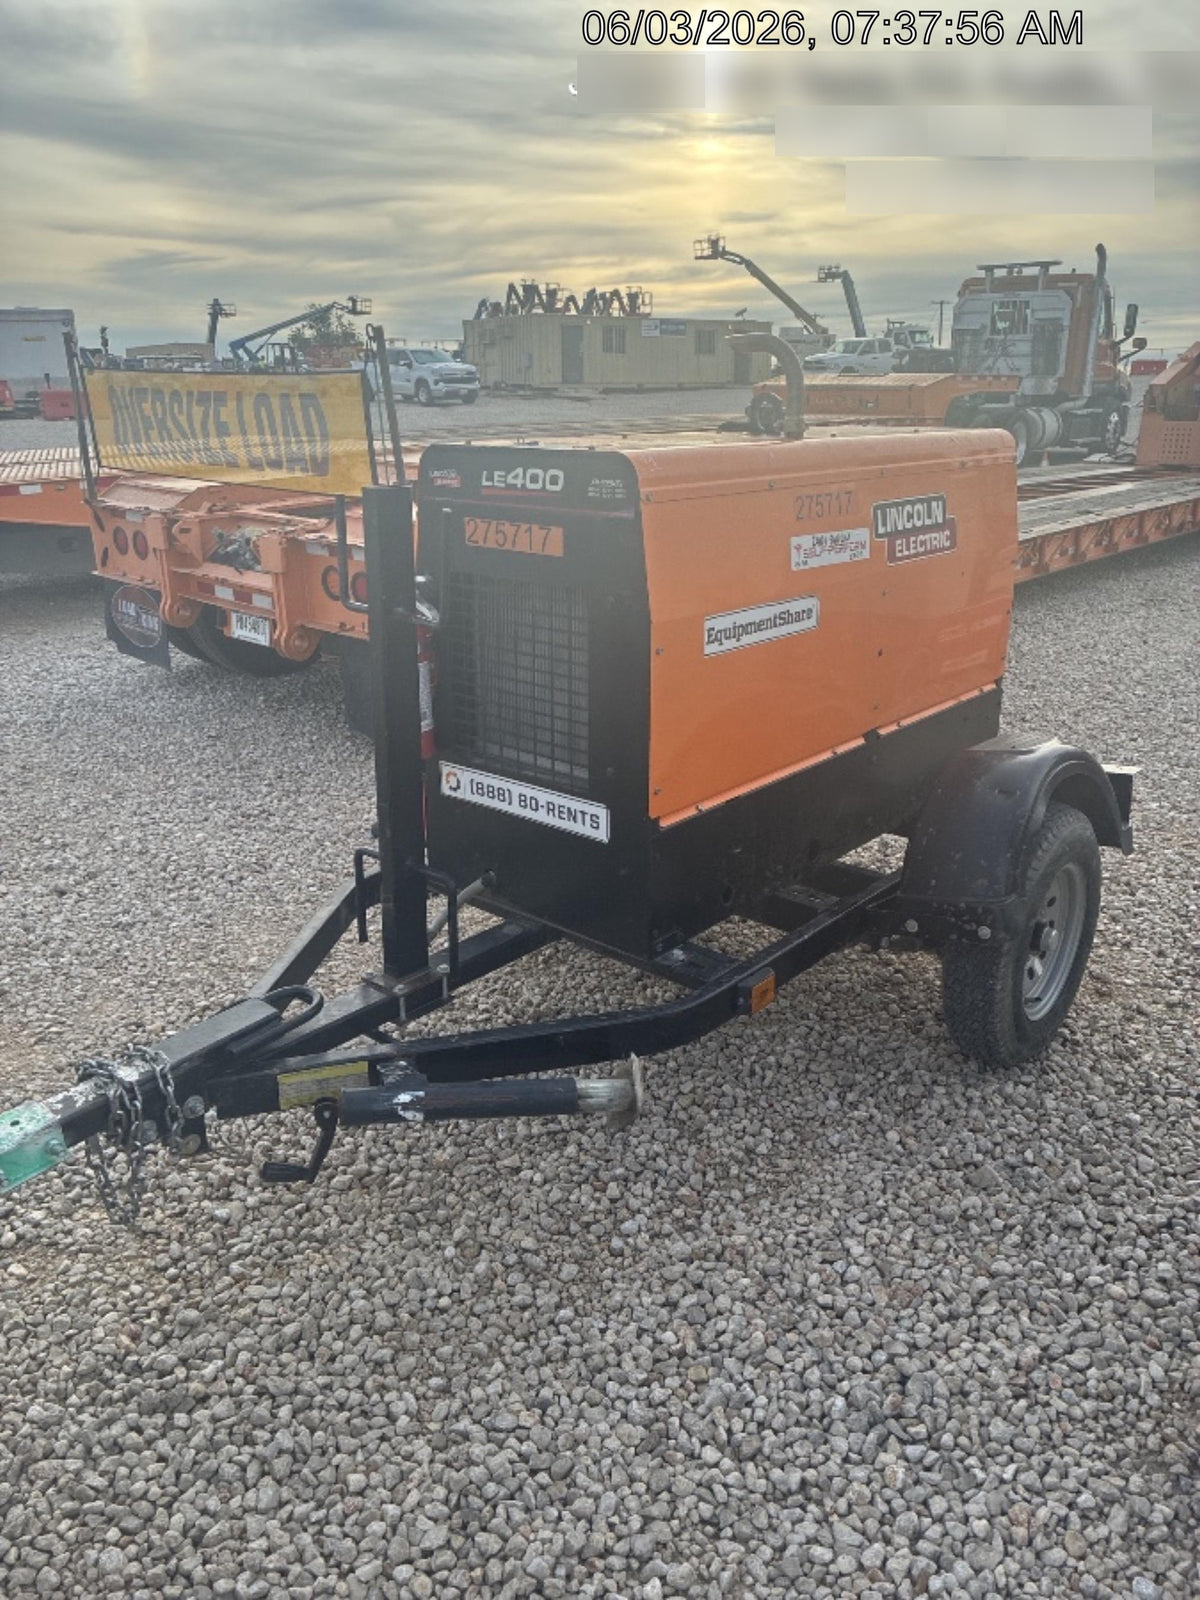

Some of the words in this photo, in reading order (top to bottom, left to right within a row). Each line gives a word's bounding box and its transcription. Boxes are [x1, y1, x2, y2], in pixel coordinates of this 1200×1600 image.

[235, 391, 330, 477] LOAD
[480, 466, 565, 492] LE400
[795, 490, 854, 522] 275717
[876, 500, 944, 534] LINCOLN
[465, 517, 553, 554] 275717
[895, 529, 951, 558] ELECTRIC
[705, 606, 814, 647] EquipmentShare
[469, 777, 513, 807] (888)
[518, 792, 601, 831] 80-RENTS
